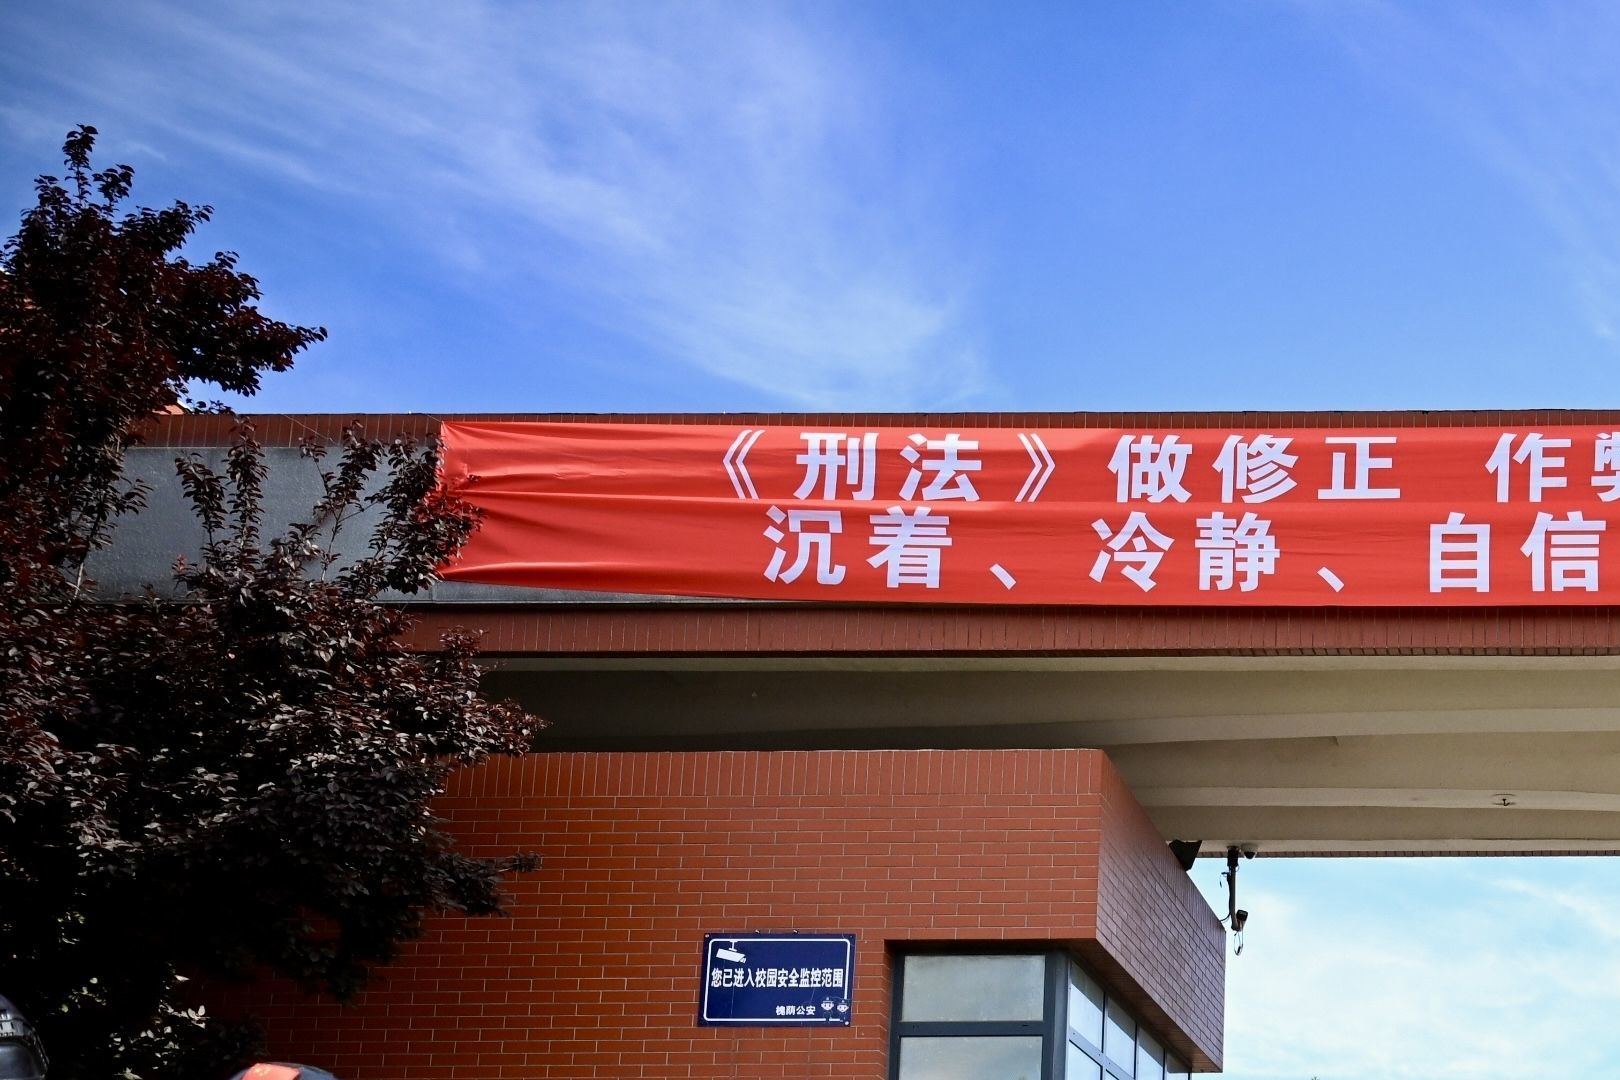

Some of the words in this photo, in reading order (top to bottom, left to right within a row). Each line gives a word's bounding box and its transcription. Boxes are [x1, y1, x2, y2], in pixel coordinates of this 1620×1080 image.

[710, 967, 844, 988] 您已进入校园安全监控范围
[775, 1005, 816, 1016] 槐荫公安
